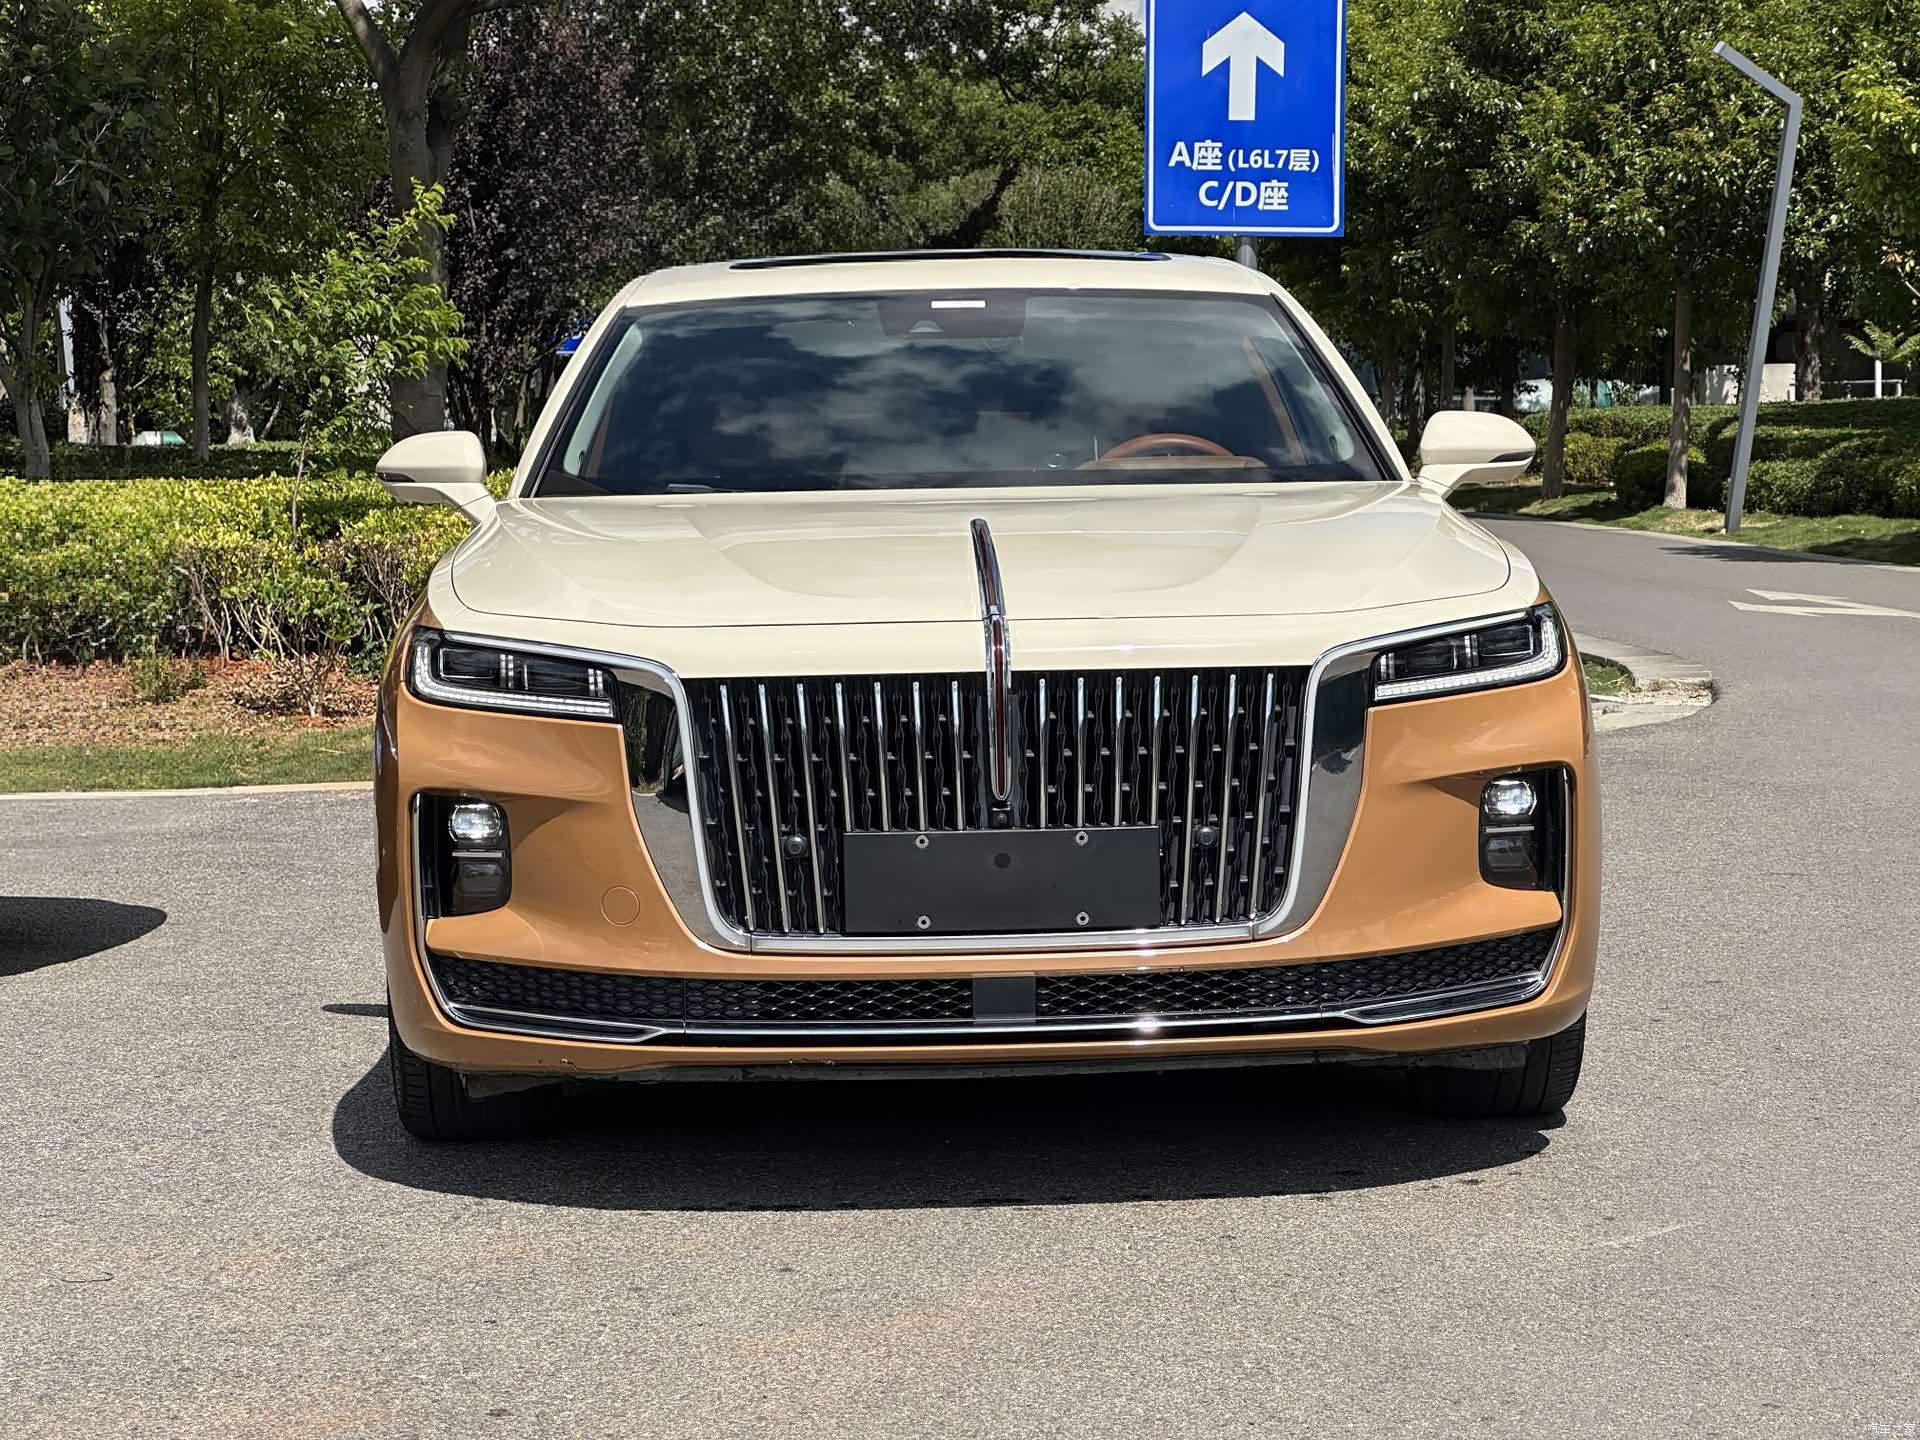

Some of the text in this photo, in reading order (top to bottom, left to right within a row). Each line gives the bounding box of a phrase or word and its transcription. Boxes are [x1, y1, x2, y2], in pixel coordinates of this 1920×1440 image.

[1168, 139, 1320, 173] A座 (L6L7层)
[1199, 179, 1289, 211] C/D座
